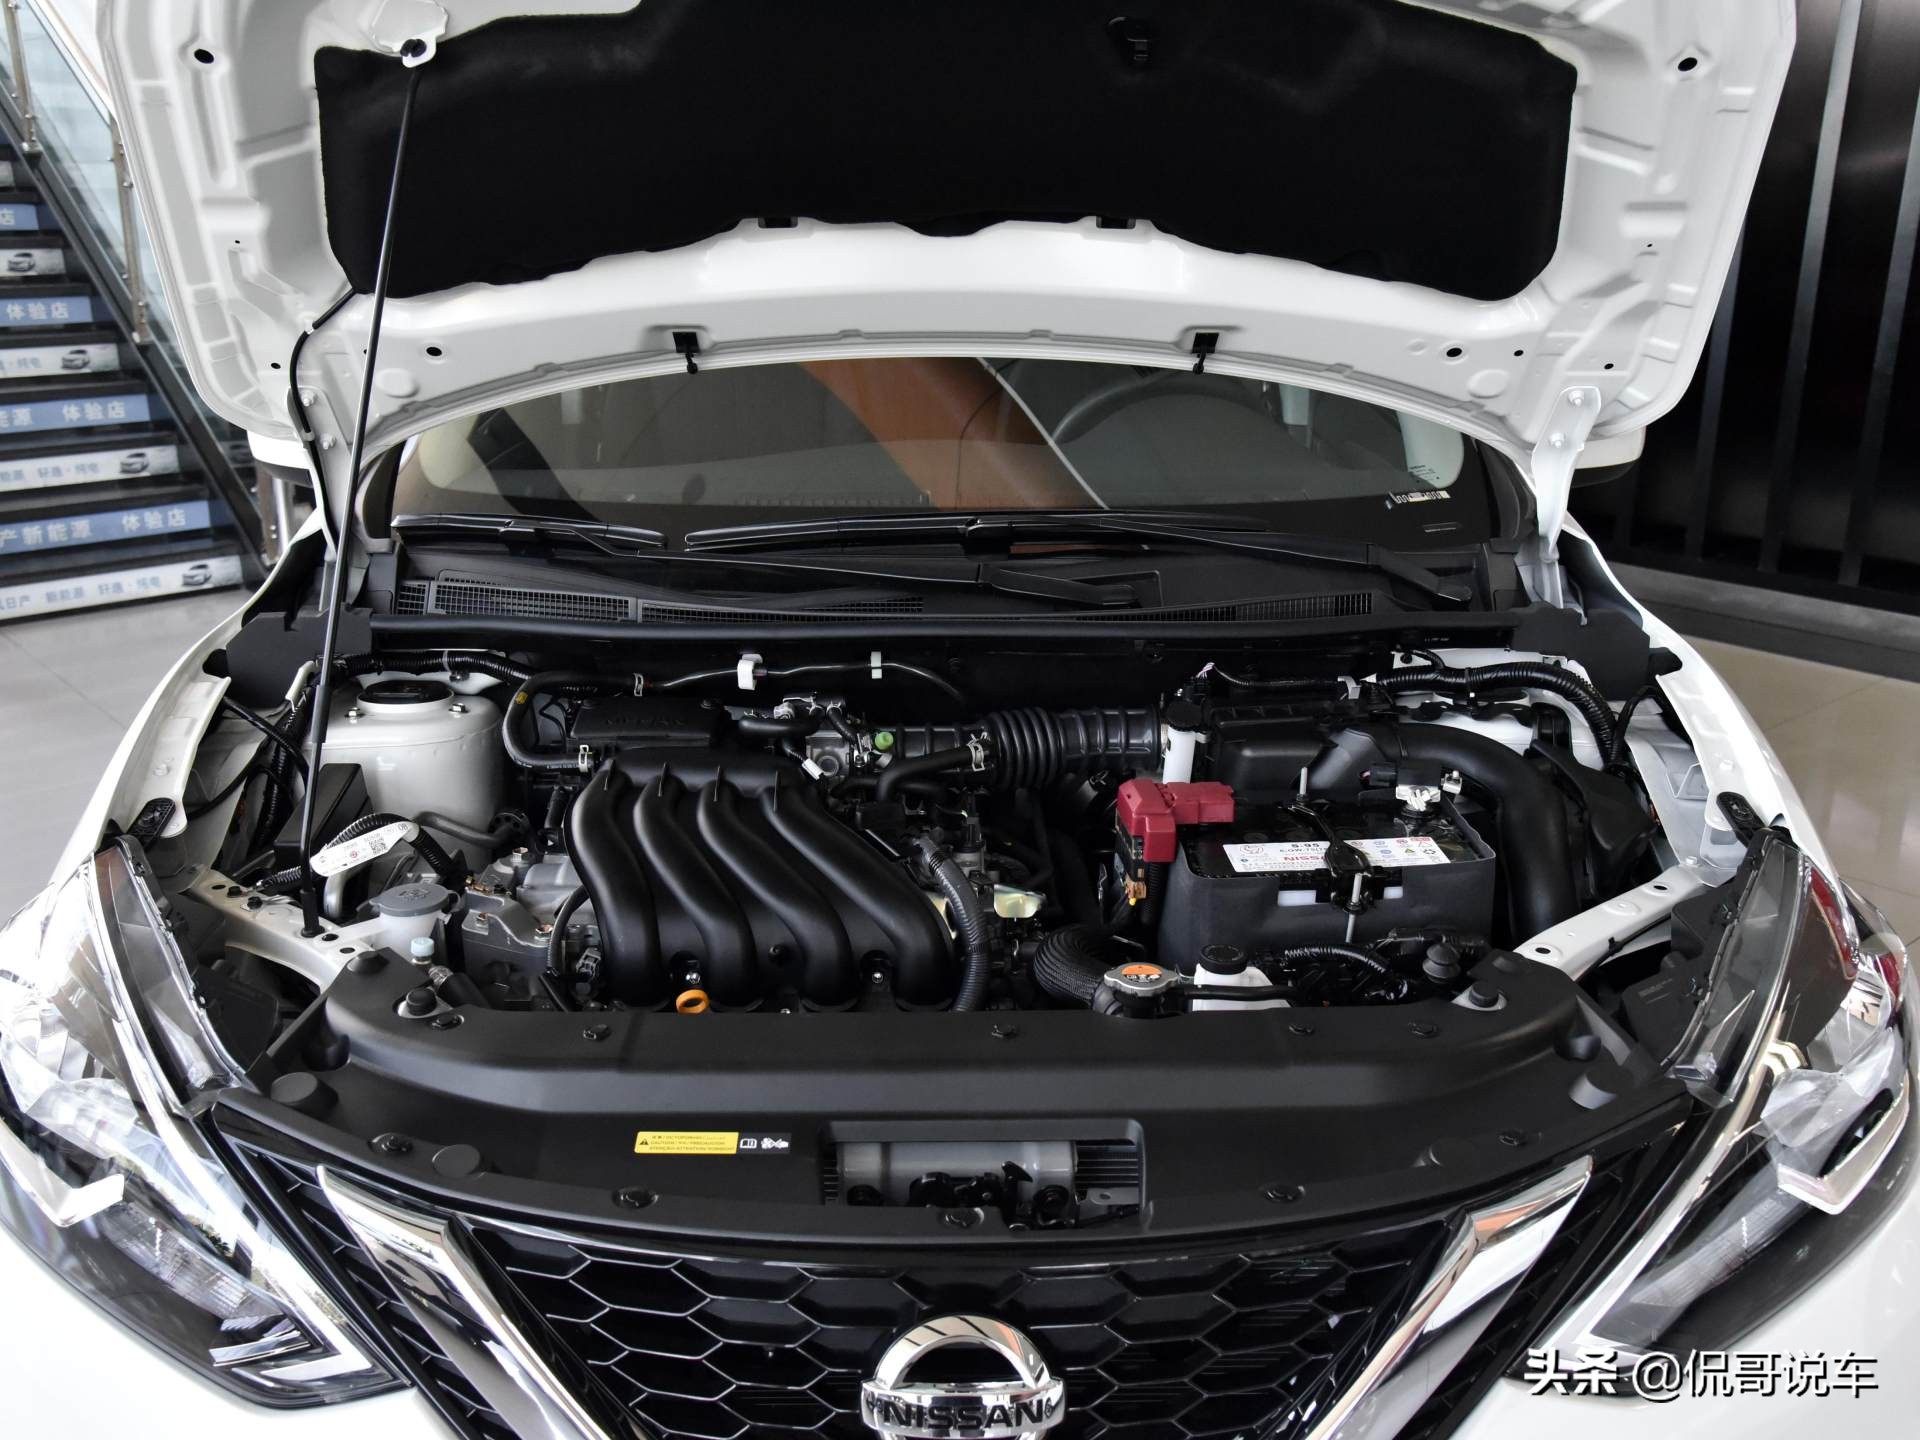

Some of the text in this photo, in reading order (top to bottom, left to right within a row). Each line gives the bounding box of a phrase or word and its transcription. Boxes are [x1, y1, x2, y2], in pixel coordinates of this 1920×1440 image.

[6, 302, 69, 320] 体验店
[62, 401, 126, 422] 体验店
[122, 508, 186, 532] 体验店
[883, 1397, 1044, 1430] NISSAN
